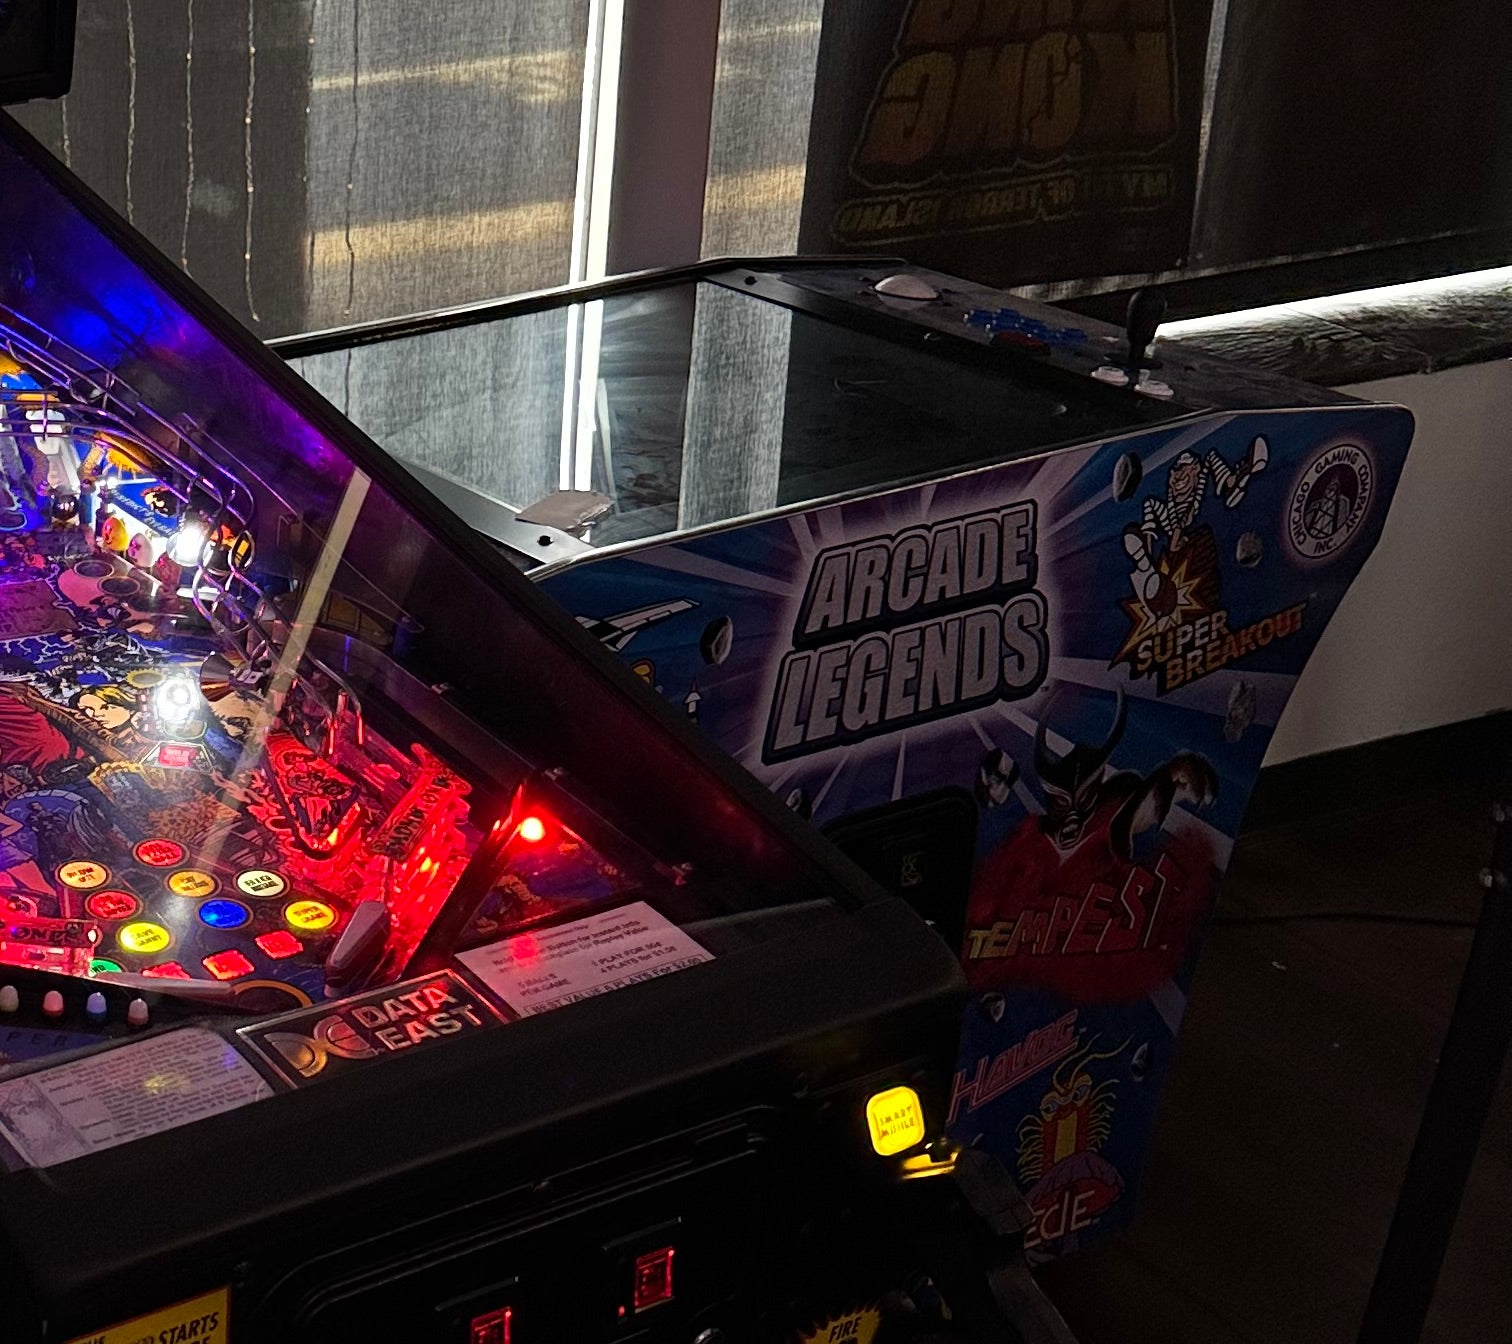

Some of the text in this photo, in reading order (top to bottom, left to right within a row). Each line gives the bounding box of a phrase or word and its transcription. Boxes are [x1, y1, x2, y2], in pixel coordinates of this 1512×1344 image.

[1292, 448, 1370, 545] CHICAGO GAMING COMPANY
[800, 504, 1034, 638] ARCADE
[1313, 538, 1337, 554] INC.
[772, 600, 1046, 752] LEGENDS
[1136, 610, 1232, 672] SUPER
[1165, 602, 1306, 690] BREAKOUT
[967, 852, 1187, 960] TEMPEST
[351, 981, 459, 1030] DATA
[374, 1004, 482, 1052] EAST
